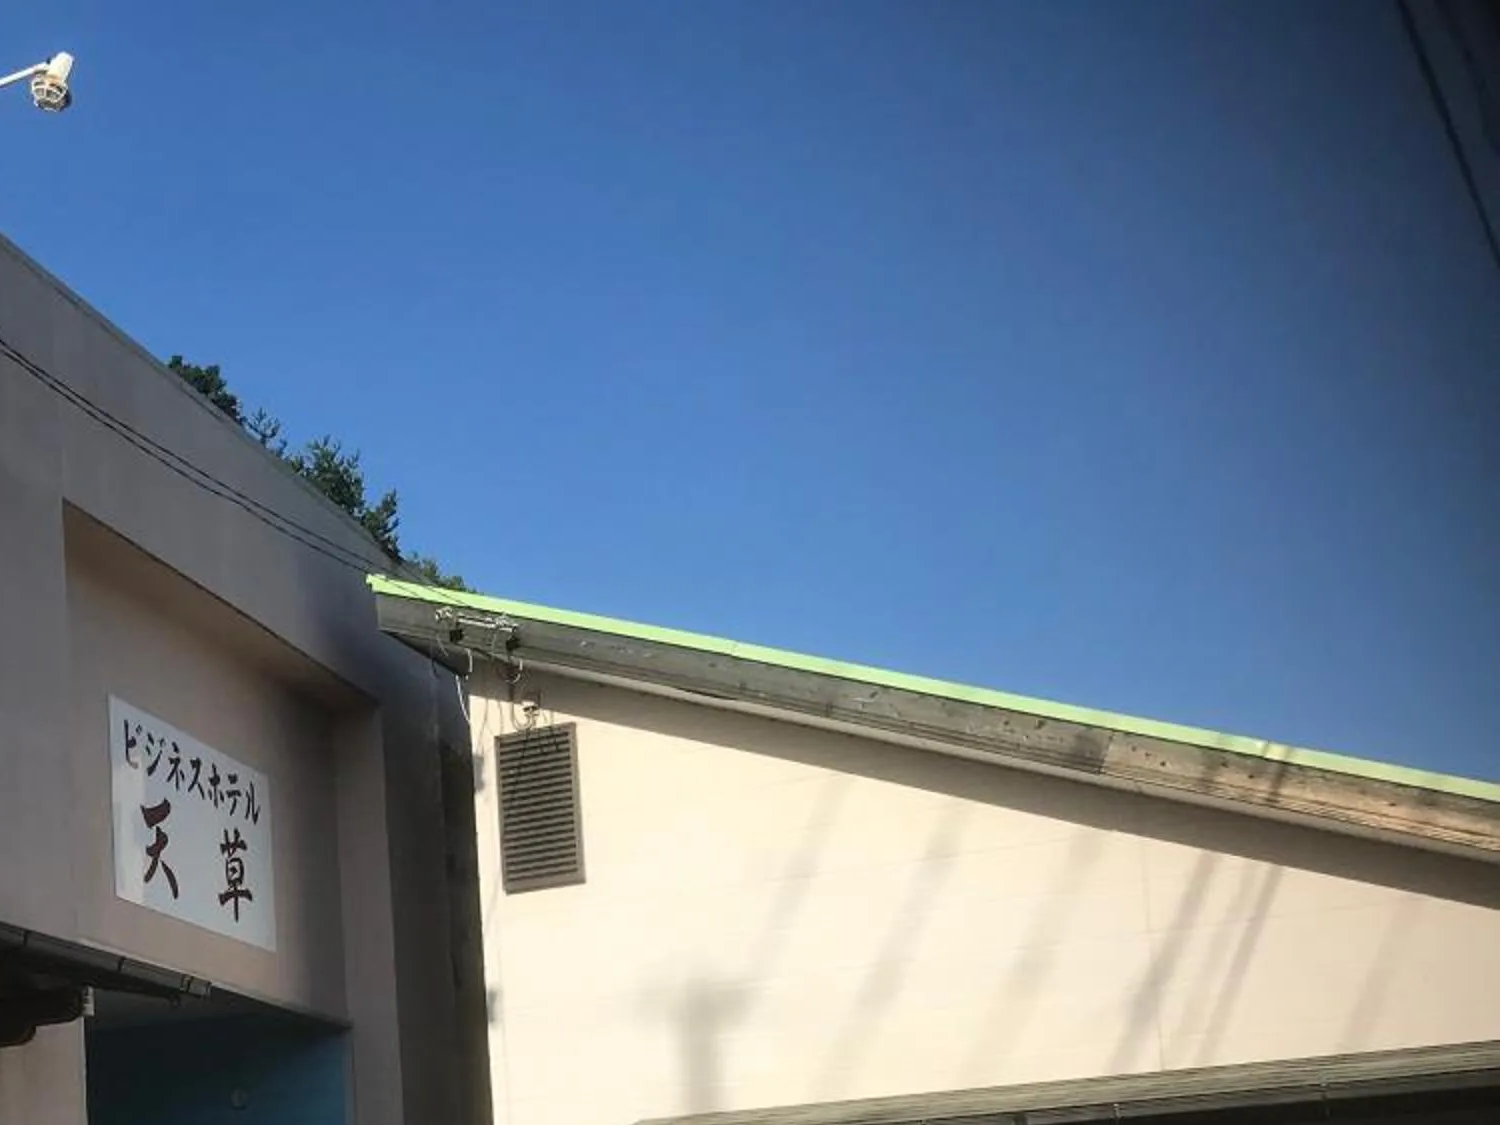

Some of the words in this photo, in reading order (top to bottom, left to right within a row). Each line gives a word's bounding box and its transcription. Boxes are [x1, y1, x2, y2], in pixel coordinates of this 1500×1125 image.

[122, 718, 261, 826] ビジネスホテル
[140, 798, 253, 923] 天草
